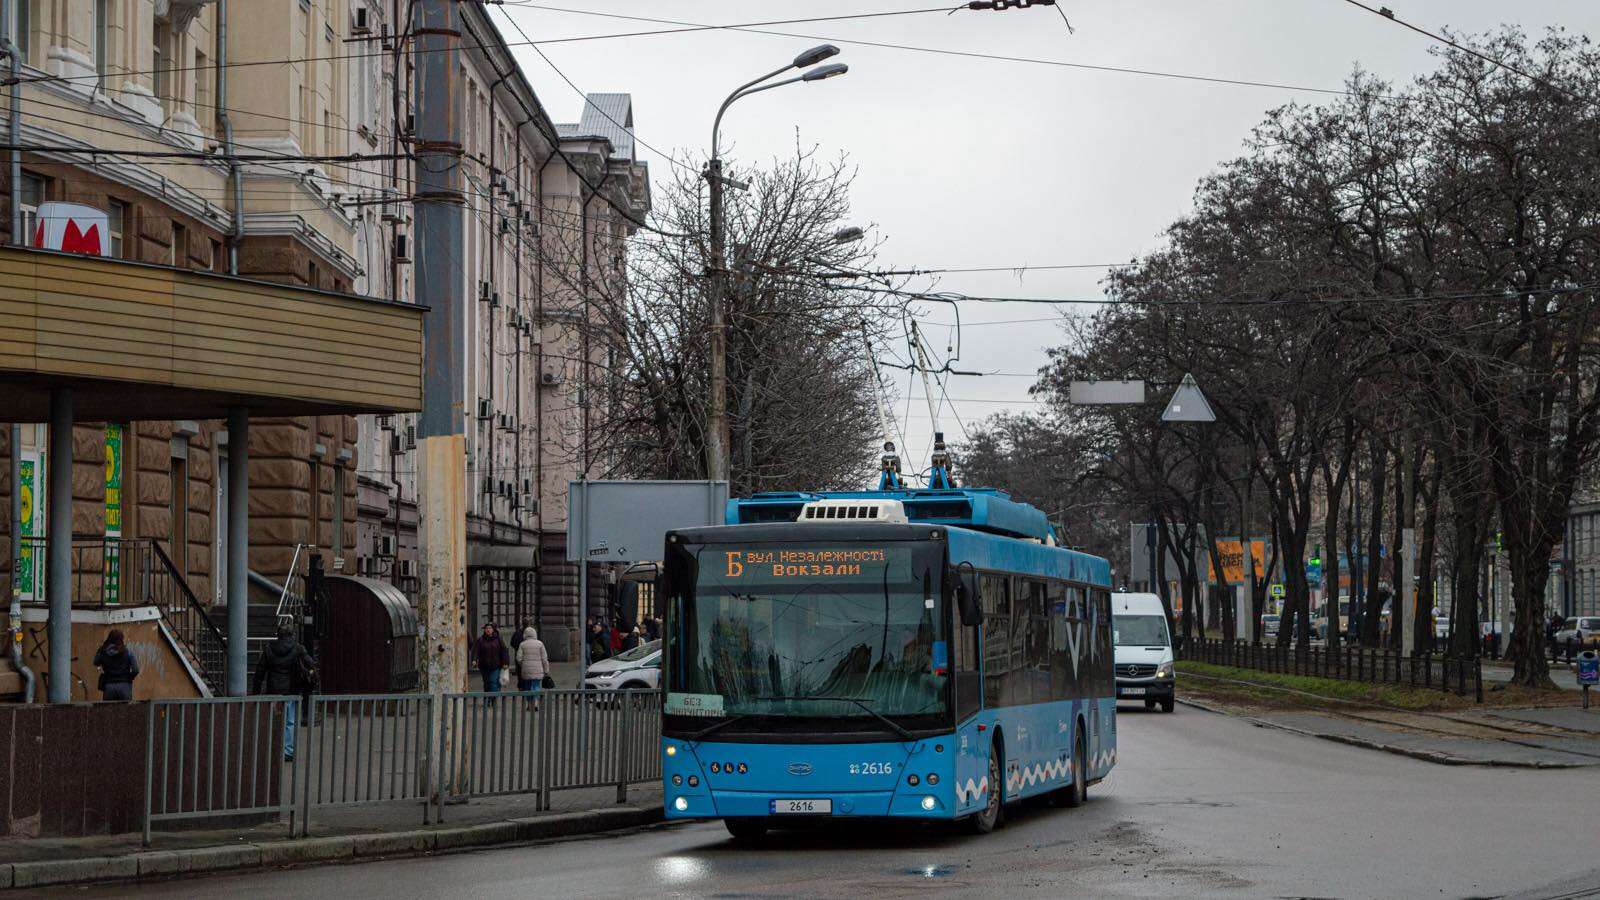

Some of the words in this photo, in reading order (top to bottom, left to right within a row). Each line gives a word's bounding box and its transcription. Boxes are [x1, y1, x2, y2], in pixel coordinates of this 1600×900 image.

[780, 549, 885, 563] Незалежності
[725, 551, 744, 577] Б
[773, 564, 861, 576] Вокзали
[684, 697, 702, 706] БЕЗ
[862, 762, 892, 775] 2616
[790, 801, 814, 812] 2616
